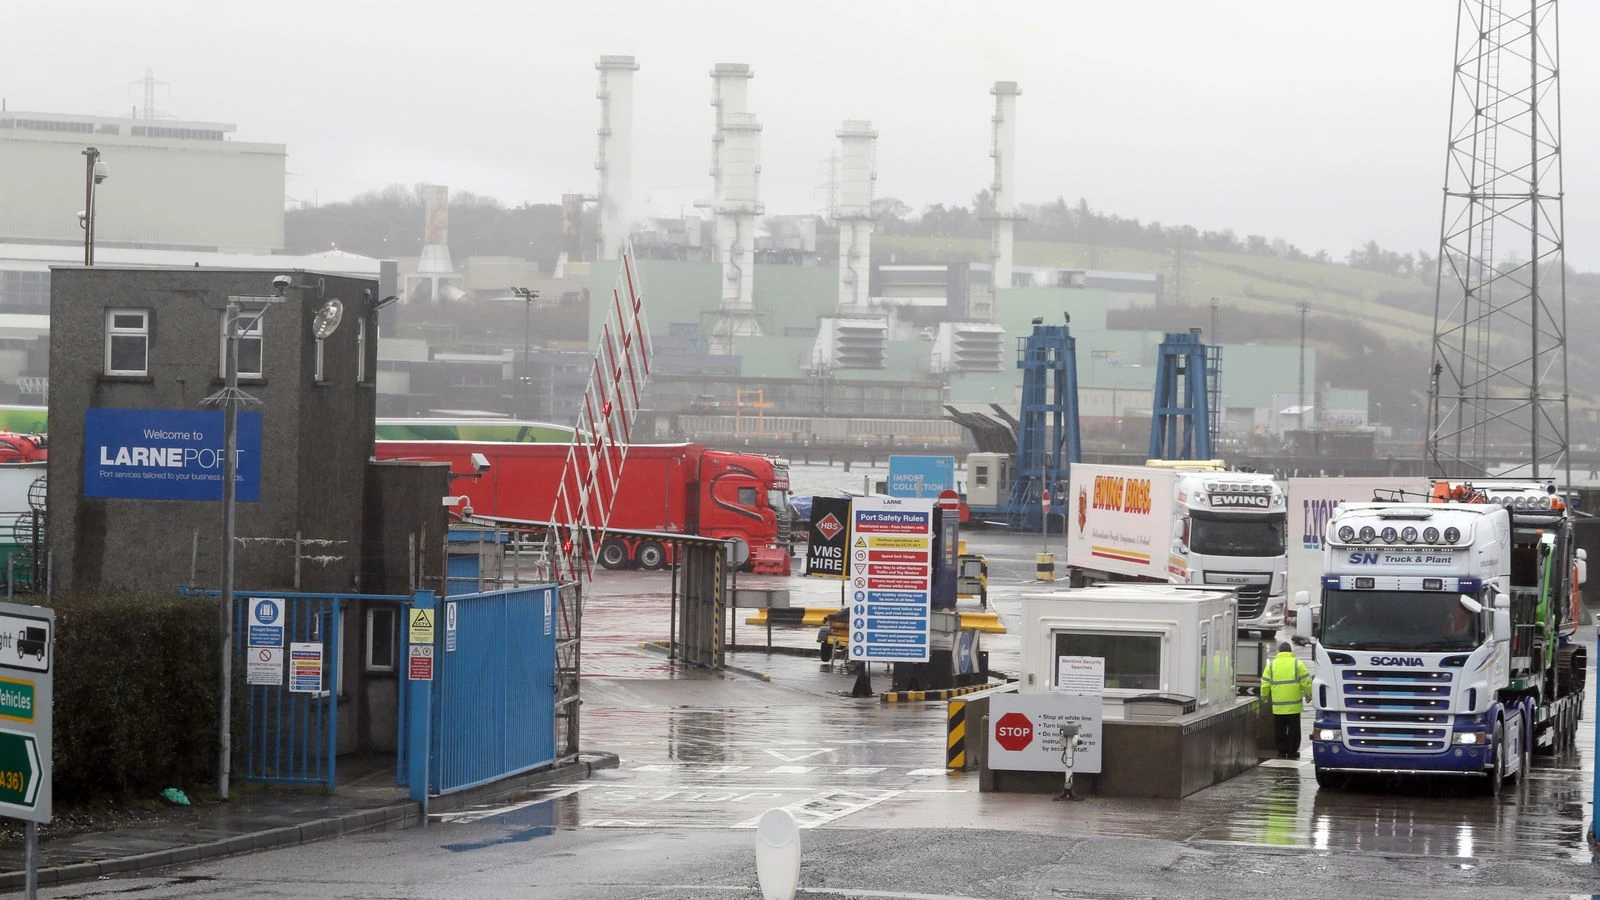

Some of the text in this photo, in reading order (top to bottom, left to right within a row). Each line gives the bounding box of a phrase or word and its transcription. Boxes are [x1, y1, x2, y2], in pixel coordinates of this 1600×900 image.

[143, 429, 204, 441] Welcome to
[100, 470, 113, 478] Port
[114, 471, 142, 479] services
[142, 471, 167, 479] tailored
[175, 473, 190, 481] your
[191, 472, 221, 481] business
[1092, 475, 1124, 511] EWING
[1211, 495, 1269, 508] EWING
[879, 514, 902, 523] Safety
[820, 522, 838, 530] HBS
[813, 545, 842, 558] VMS
[810, 557, 843, 571] HIRE
[1349, 552, 1379, 565] SN
[1425, 556, 1452, 564] Plant
[1370, 656, 1424, 667] SCANIA
[999, 727, 1030, 737] STOP
